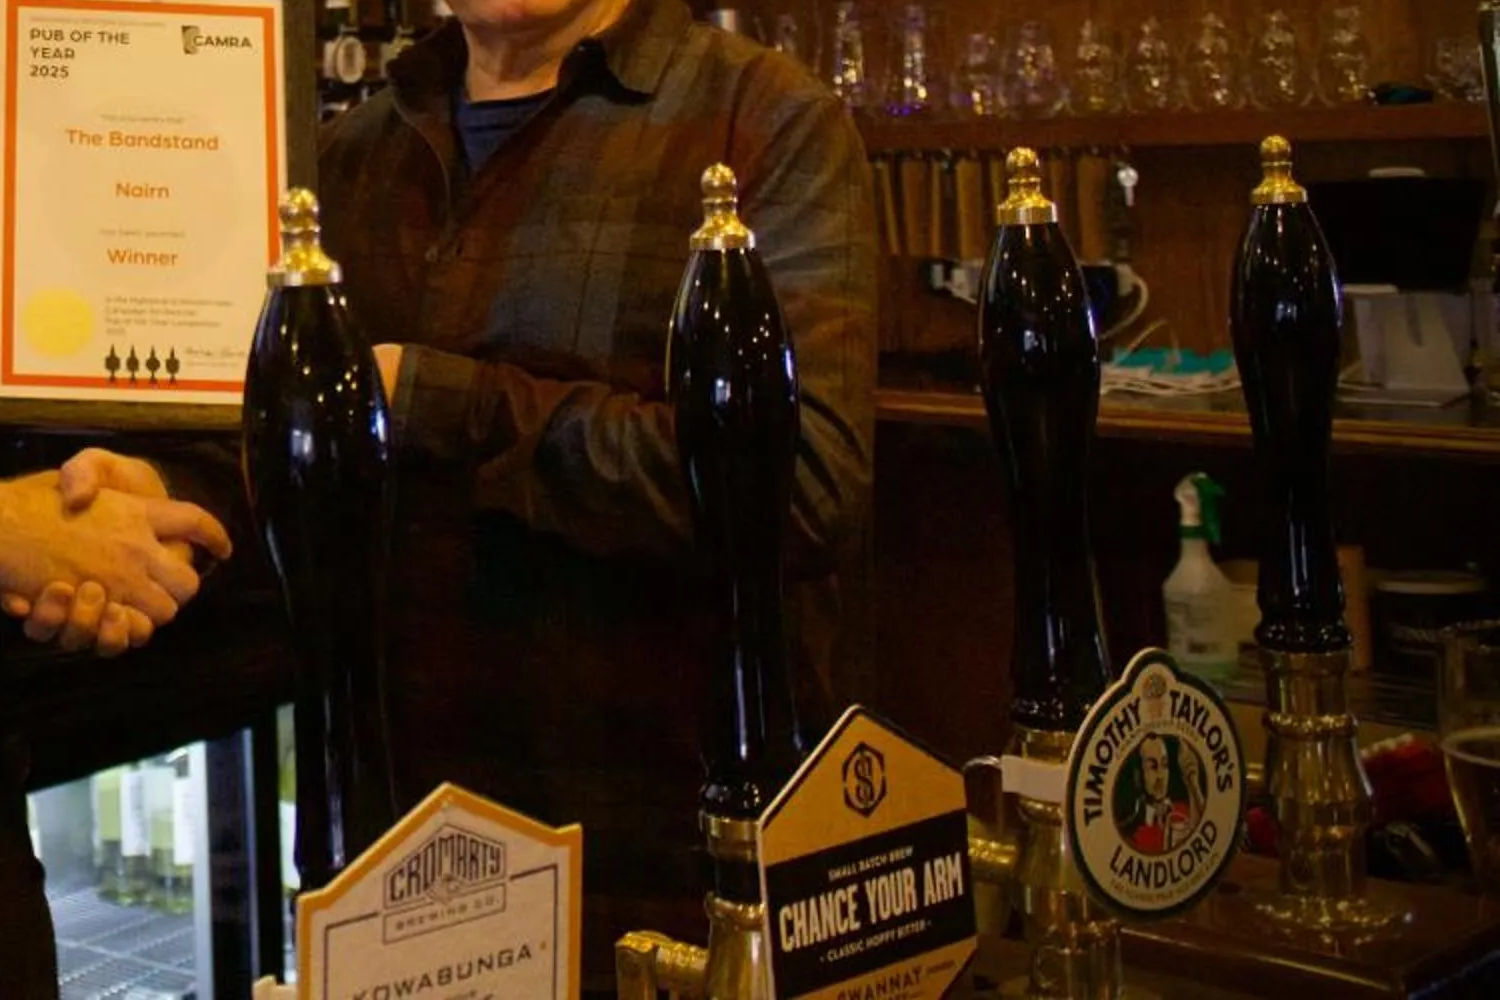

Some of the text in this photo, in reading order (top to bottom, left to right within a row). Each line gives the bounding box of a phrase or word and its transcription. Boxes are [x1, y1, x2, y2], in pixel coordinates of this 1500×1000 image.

[30, 27, 131, 45] PUB OF THE
[192, 34, 253, 49] CAMRA
[29, 46, 75, 60] YEAR
[29, 64, 70, 79] 2025
[65, 128, 219, 152] The Bandstand
[114, 181, 170, 200] Nairn
[107, 247, 179, 268] Winner
[1083, 690, 1234, 826] TIMOTHY TAYLOR'S
[389, 832, 502, 902] CROMARTY
[828, 845, 914, 883] SMALL BATCH BREW
[1110, 820, 1218, 889] LANDLORD
[779, 852, 965, 954] CHANCE YOUR ARM
[826, 918, 927, 963] CLASSIC HOPPY BITTER
[351, 944, 532, 1000] KOWABUNGA
